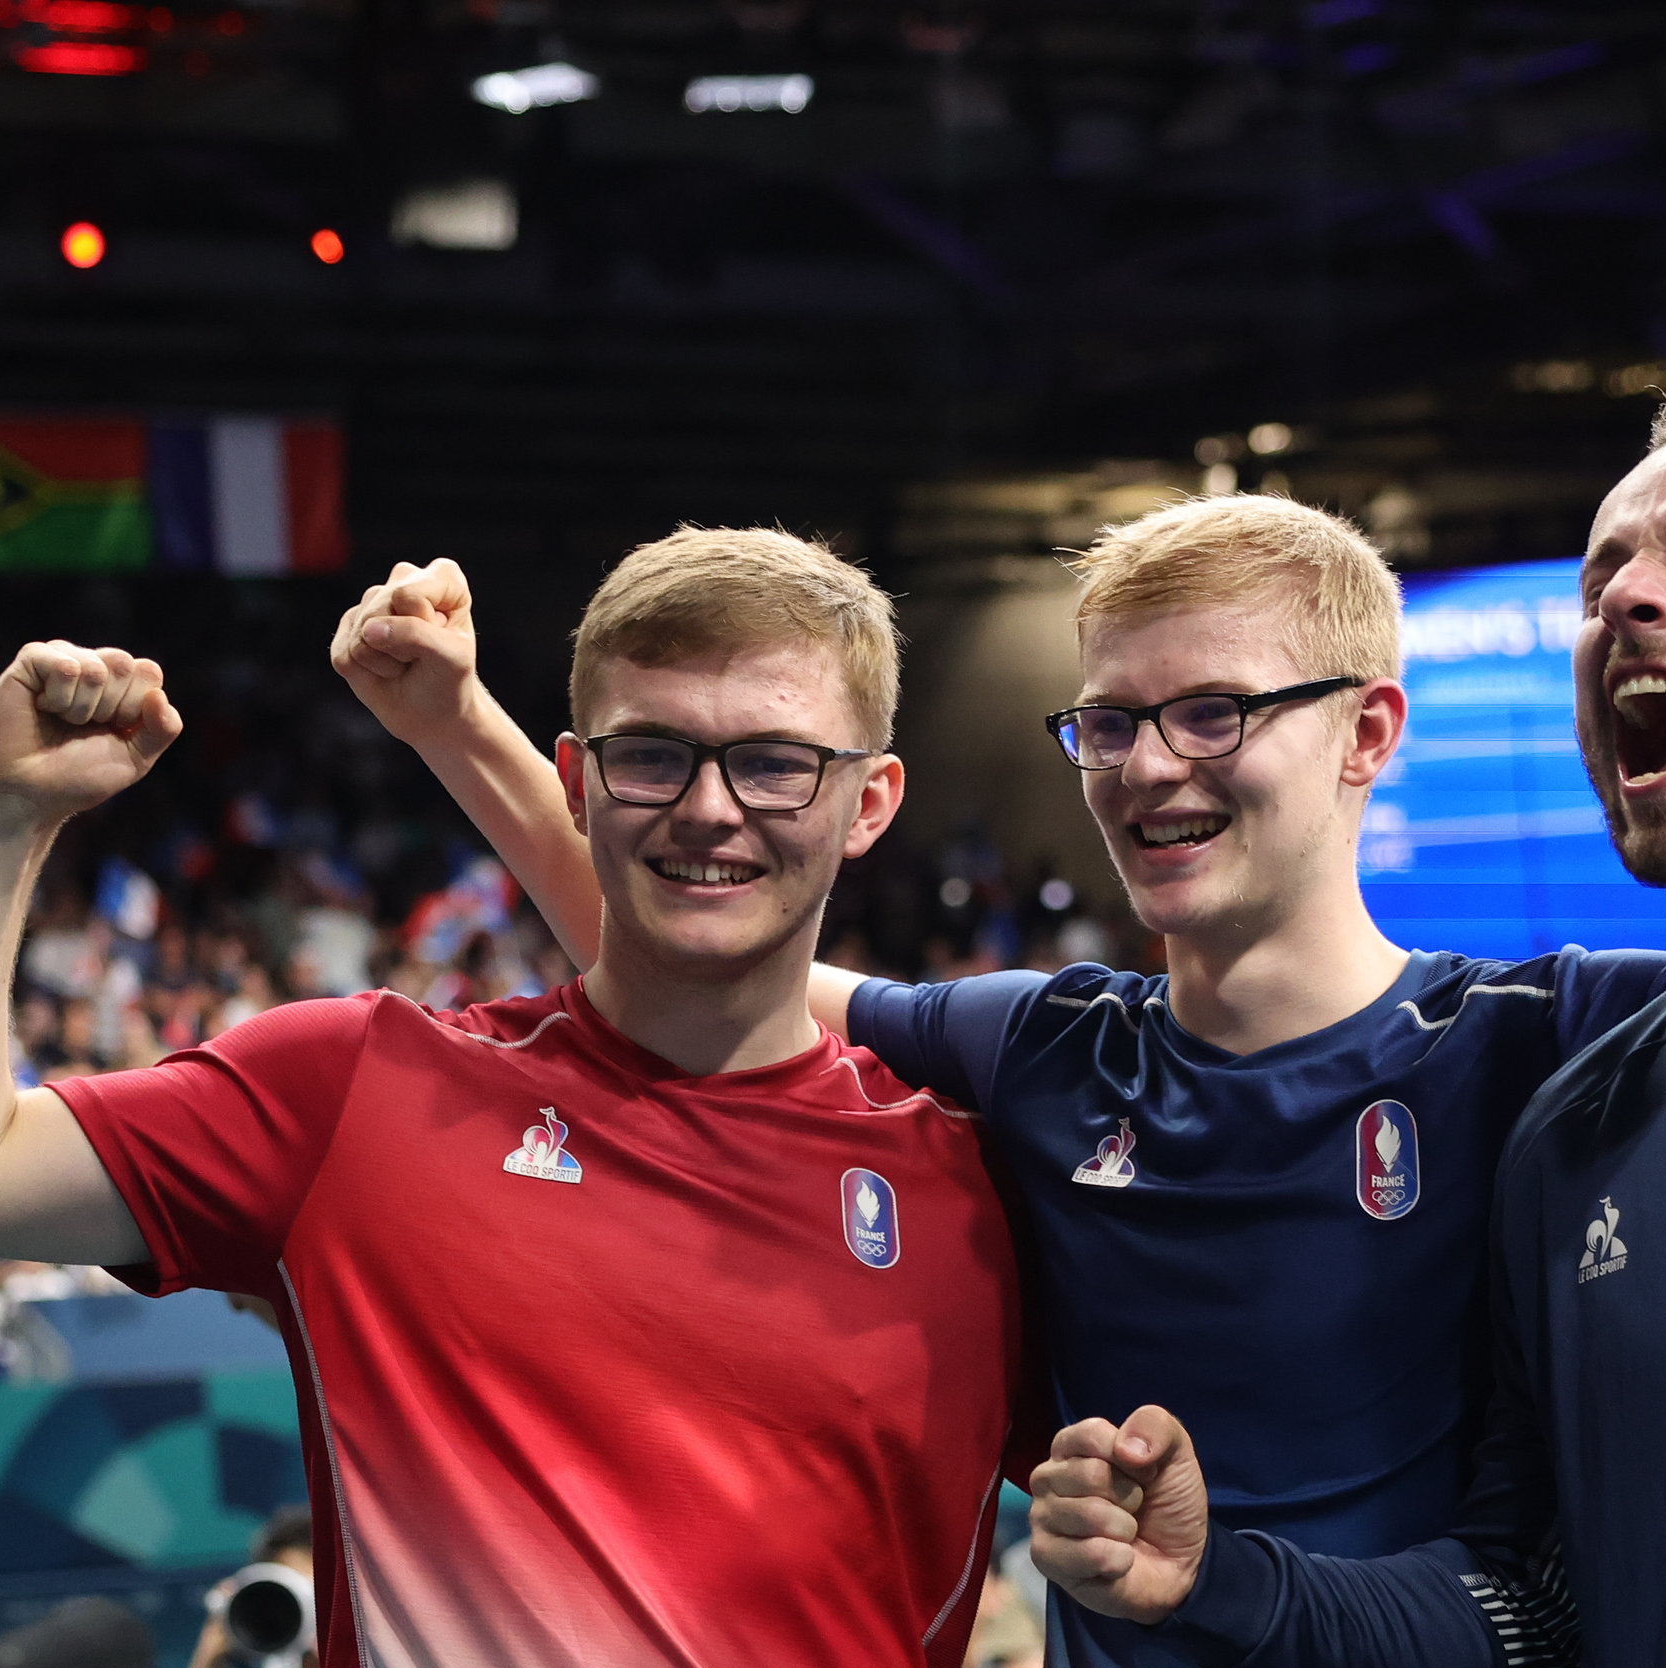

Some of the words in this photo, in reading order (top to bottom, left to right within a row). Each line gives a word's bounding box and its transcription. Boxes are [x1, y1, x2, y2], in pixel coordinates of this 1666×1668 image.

[506, 1160, 518, 1172] LE
[520, 1163, 539, 1176] COQ
[541, 1167, 580, 1181] SPORTIF
[1372, 1174, 1406, 1188] FRANCE
[856, 1227, 886, 1243] FRANCE
